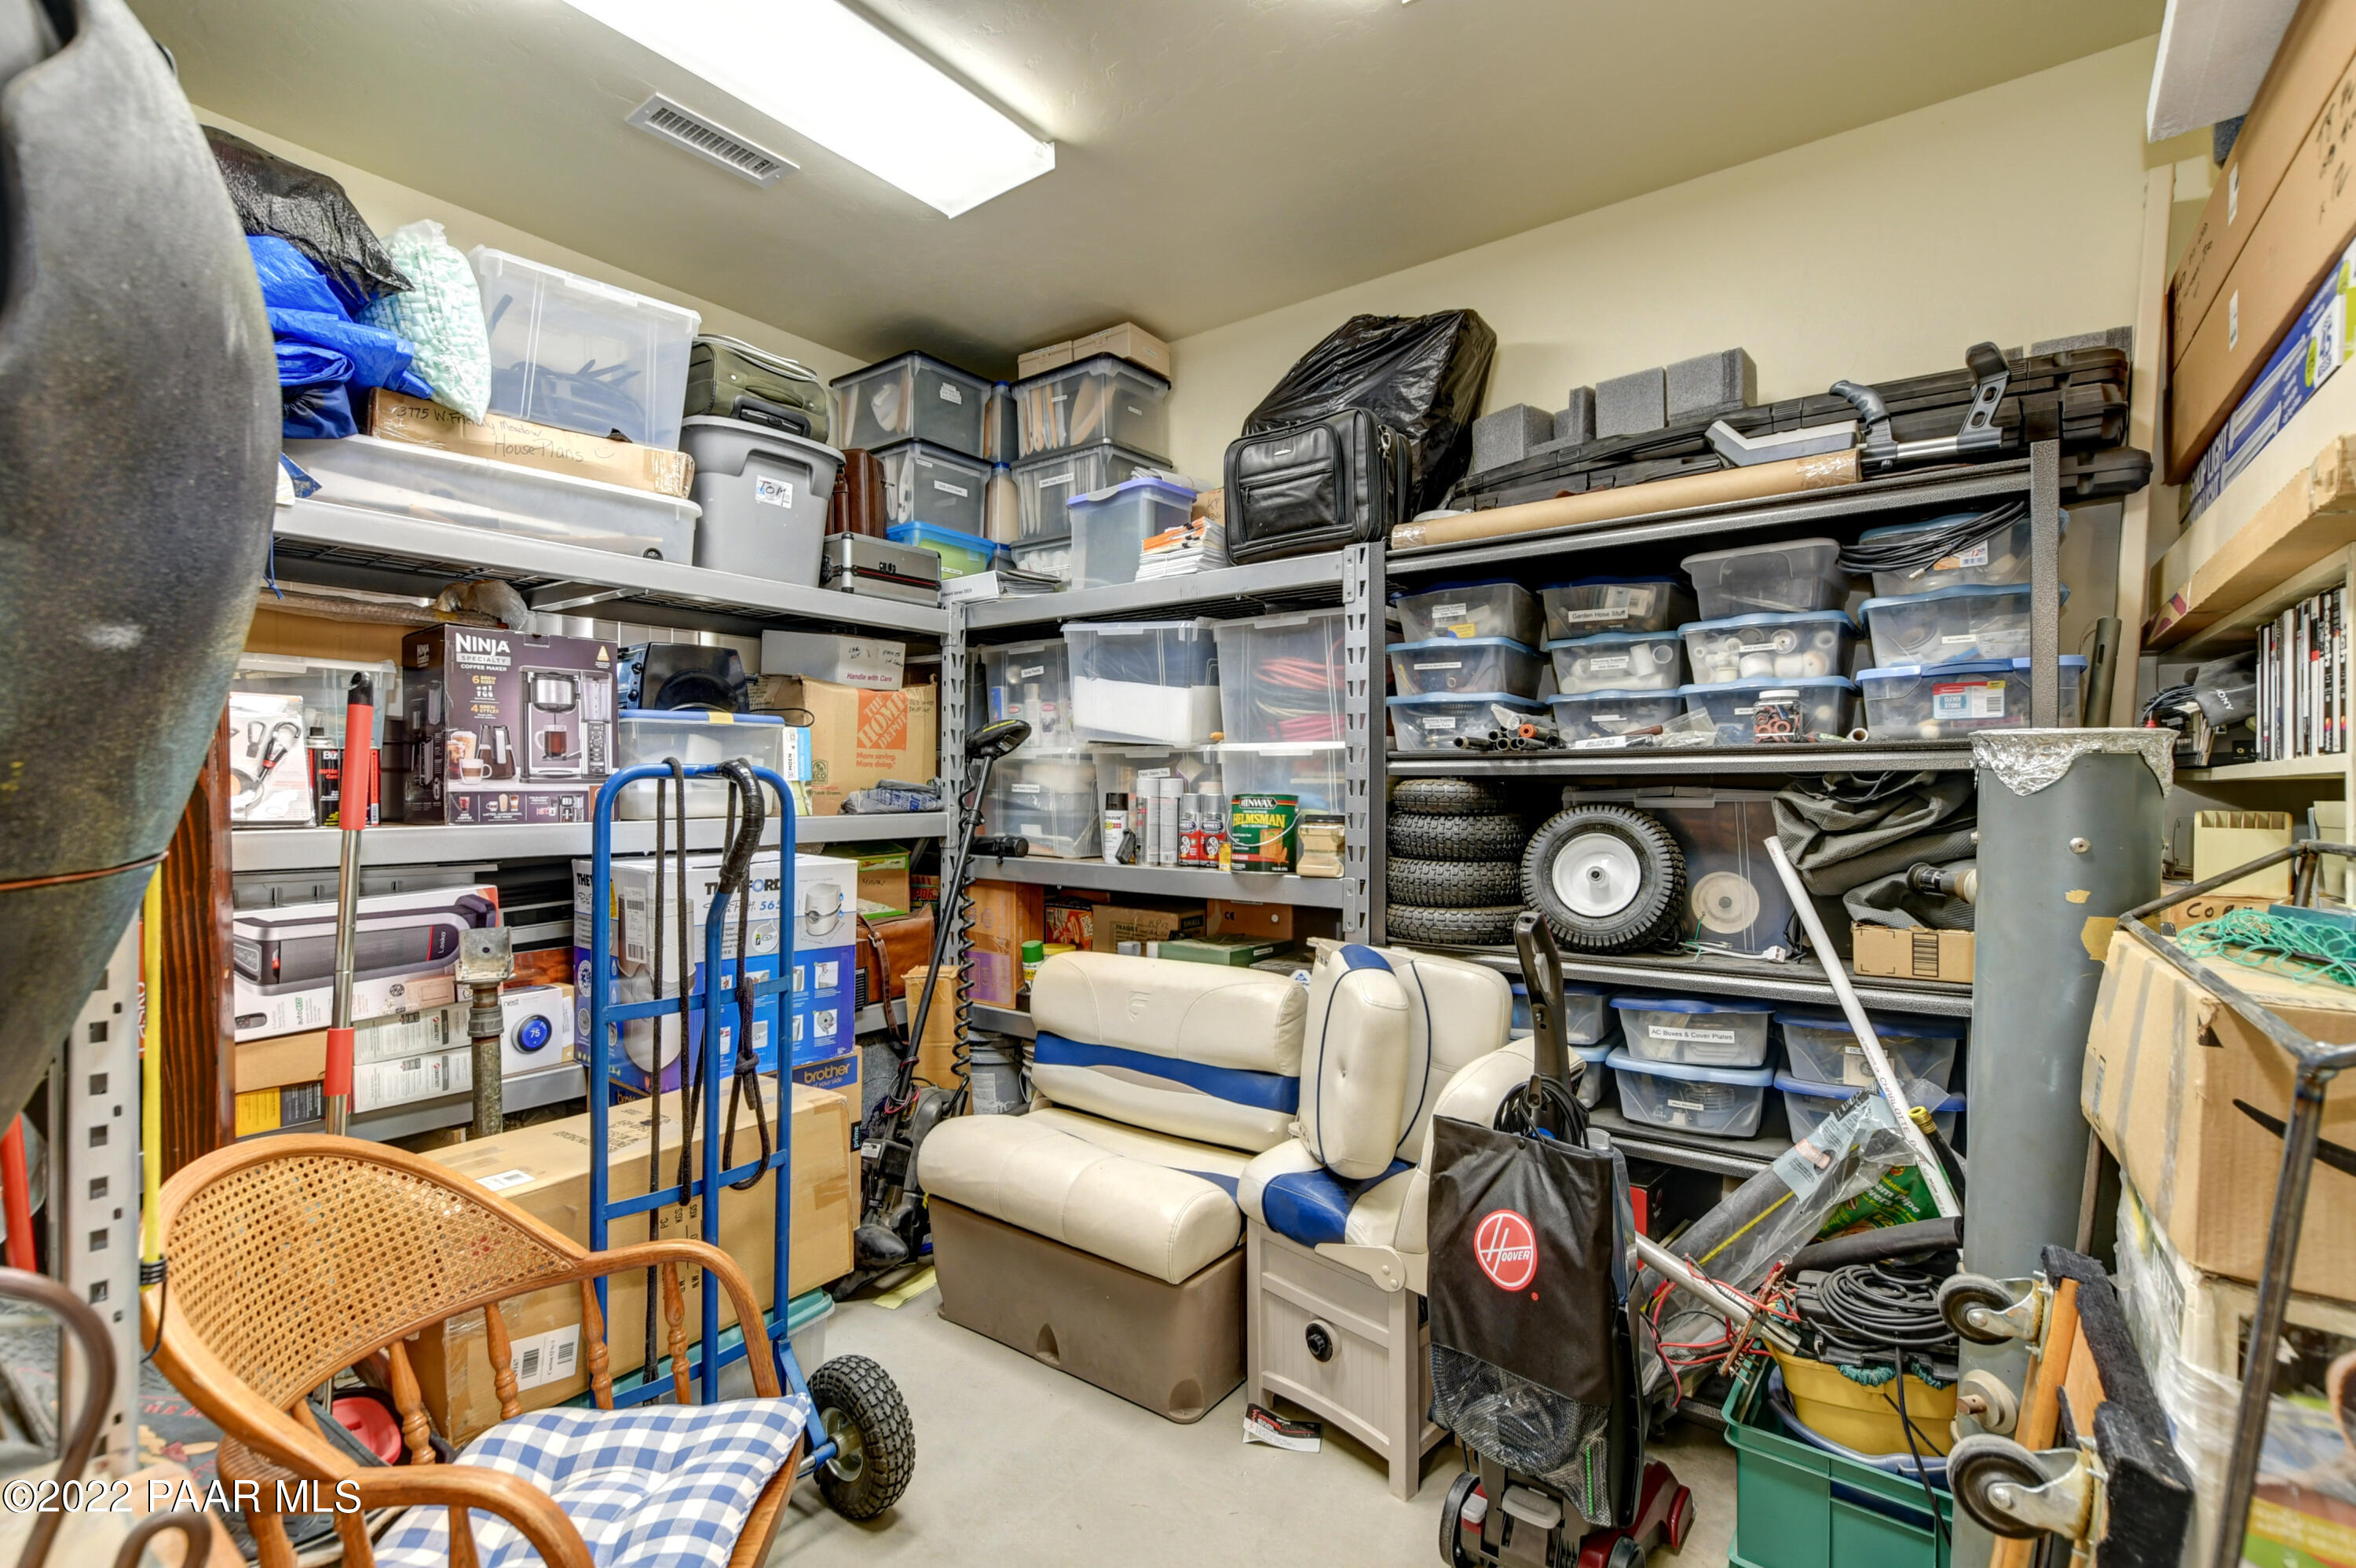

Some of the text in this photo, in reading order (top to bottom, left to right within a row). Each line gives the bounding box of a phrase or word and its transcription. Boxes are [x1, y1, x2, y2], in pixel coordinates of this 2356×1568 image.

[397, 405, 430, 418] 3775
[494, 435, 584, 462] House Plans
[759, 480, 787, 507] TOM
[1571, 611, 1593, 620] Garden
[455, 632, 510, 656] NINJA
[460, 655, 507, 663] SPECIALTY
[472, 675, 480, 685] 6
[470, 704, 479, 714] 4
[863, 695, 886, 719] THE
[1232, 813, 1287, 829] HELMSMAN
[1182, 916, 1202, 927] SMALL
[1224, 911, 1235, 920] CE
[1115, 923, 1139, 933] FRAGILE
[438, 931, 447, 954] Lasko
[503, 999, 519, 1008] nest
[529, 1029, 541, 1038] 75
[803, 1063, 851, 1084] brother
[1879, 1076, 1912, 1134] CHARLOTTE
[852, 1125, 861, 1150] prime
[1876, 1182, 1897, 1200] am
[1896, 1191, 1922, 1215] pipe
[675, 1208, 683, 1224] KGS
[690, 1204, 698, 1219] KGS
[660, 1217, 669, 1230] PC
[1480, 1215, 1531, 1276] HOOVER
